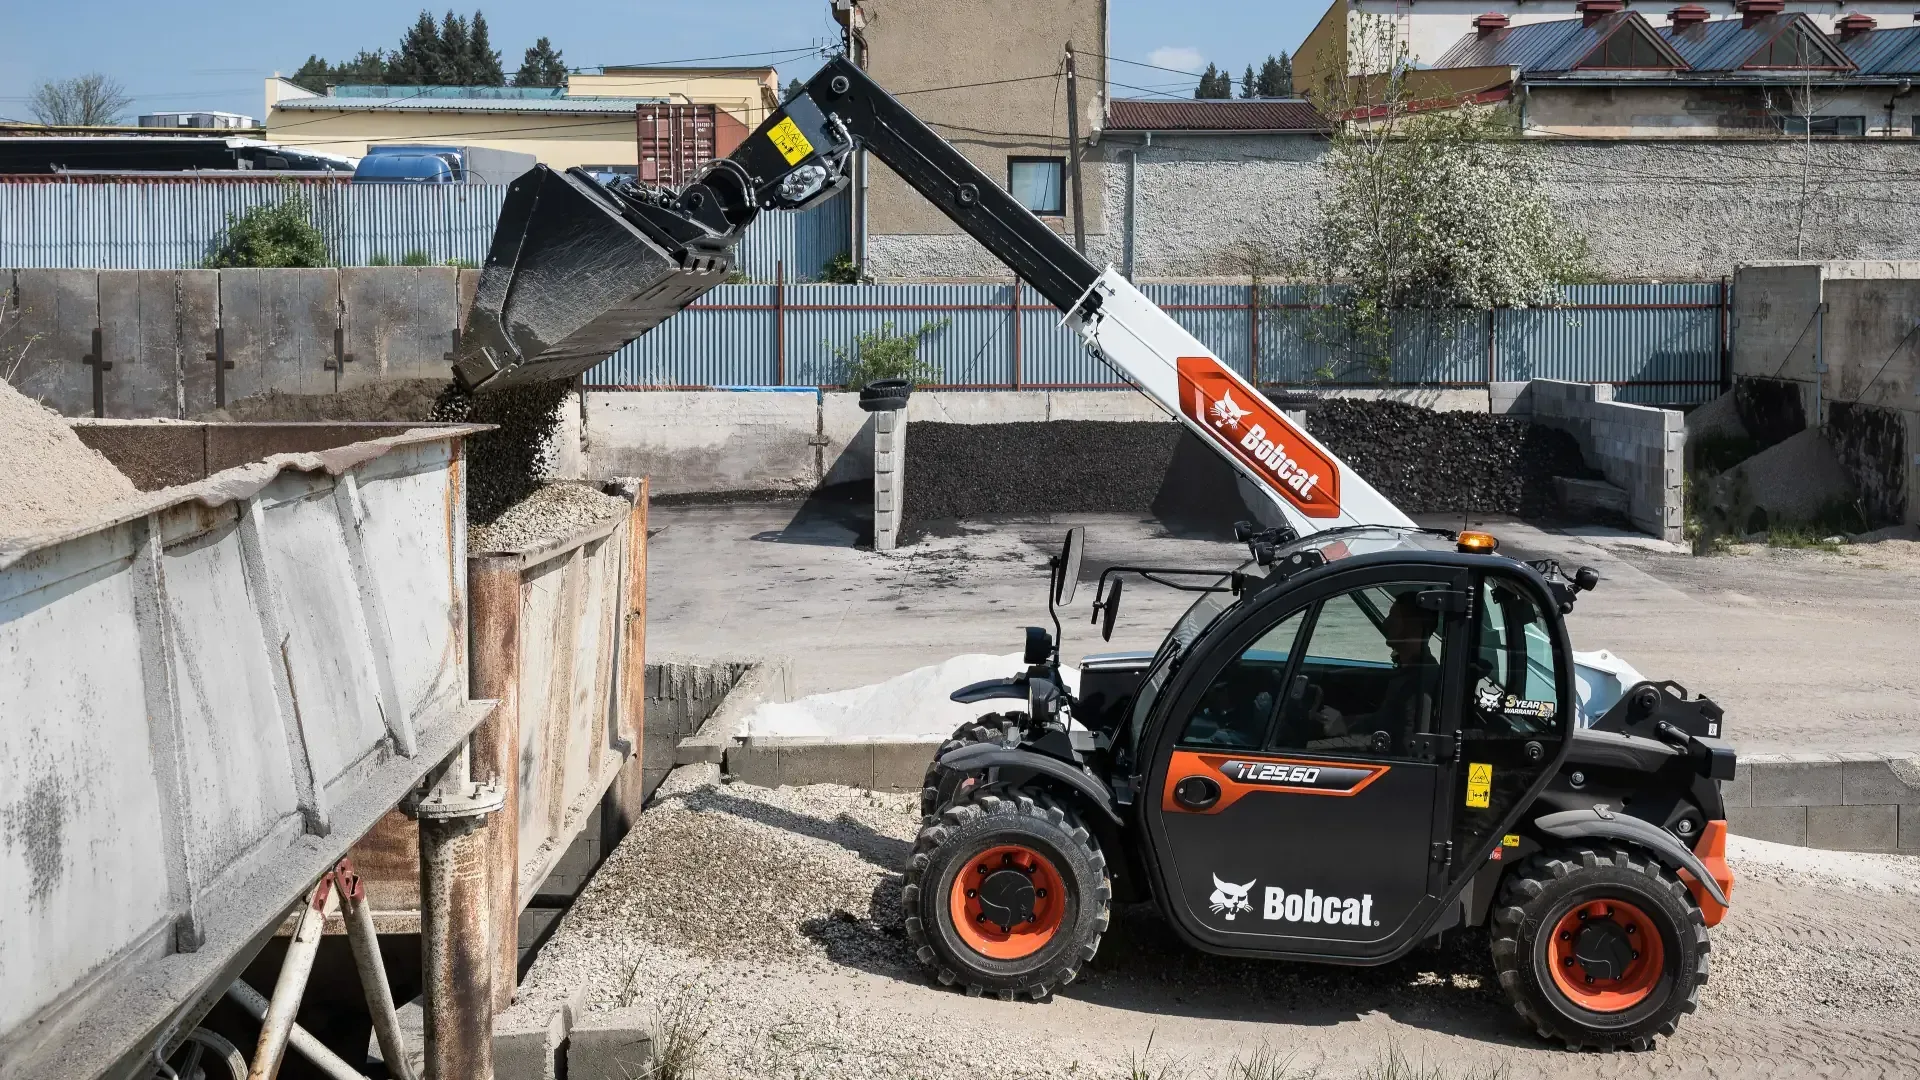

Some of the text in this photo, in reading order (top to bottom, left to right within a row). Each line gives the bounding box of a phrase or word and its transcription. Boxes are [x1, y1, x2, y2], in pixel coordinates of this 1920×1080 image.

[1240, 423, 1319, 497] Bobcat
[1504, 708, 1539, 716] WARRANTY
[1505, 695, 1540, 709] 3 YEAR
[1237, 763, 1321, 783] TL25.60
[1263, 886, 1373, 927] Bobcat
